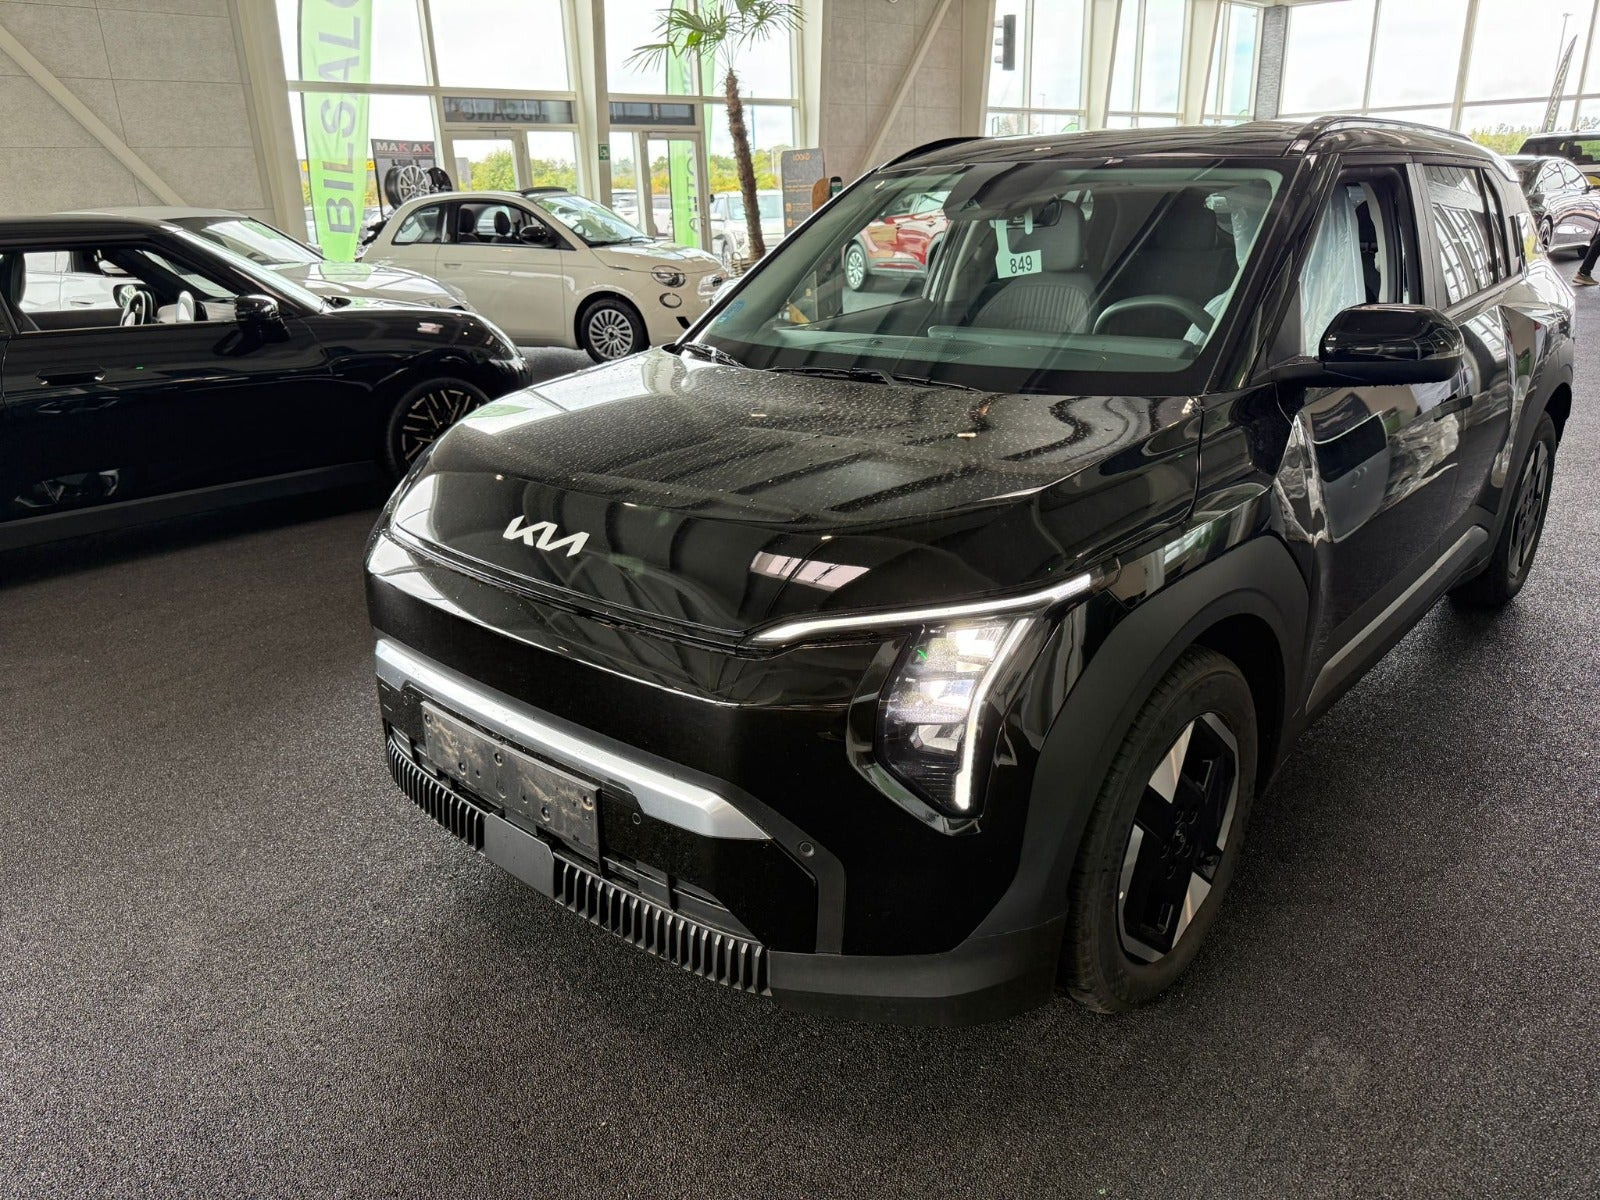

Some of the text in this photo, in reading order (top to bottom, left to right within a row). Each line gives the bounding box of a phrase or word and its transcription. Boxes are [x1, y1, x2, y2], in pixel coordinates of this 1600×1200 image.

[318, 0, 361, 235] BILSAL
[1009, 255, 1033, 274] 849
[502, 515, 590, 558] KIA
